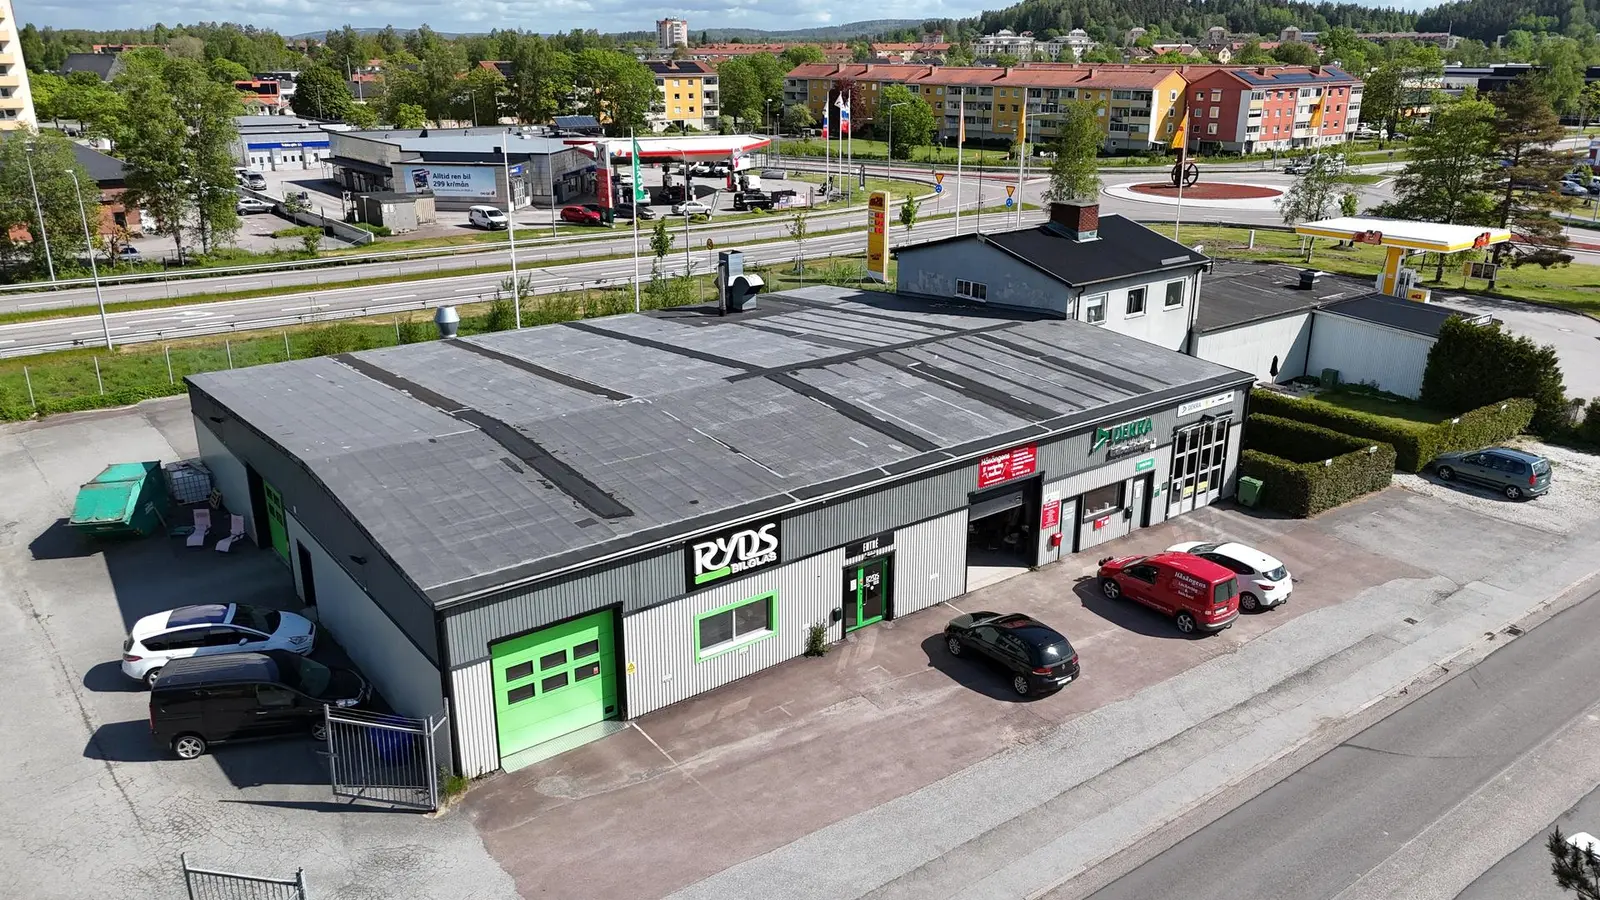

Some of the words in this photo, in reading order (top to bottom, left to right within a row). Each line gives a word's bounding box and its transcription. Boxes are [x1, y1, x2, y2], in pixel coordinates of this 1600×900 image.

[1111, 416, 1152, 443] DEKRA
[693, 523, 778, 575] RYDS
[863, 537, 878, 552] ENTRÉ
[731, 551, 777, 573] BILGLAS
